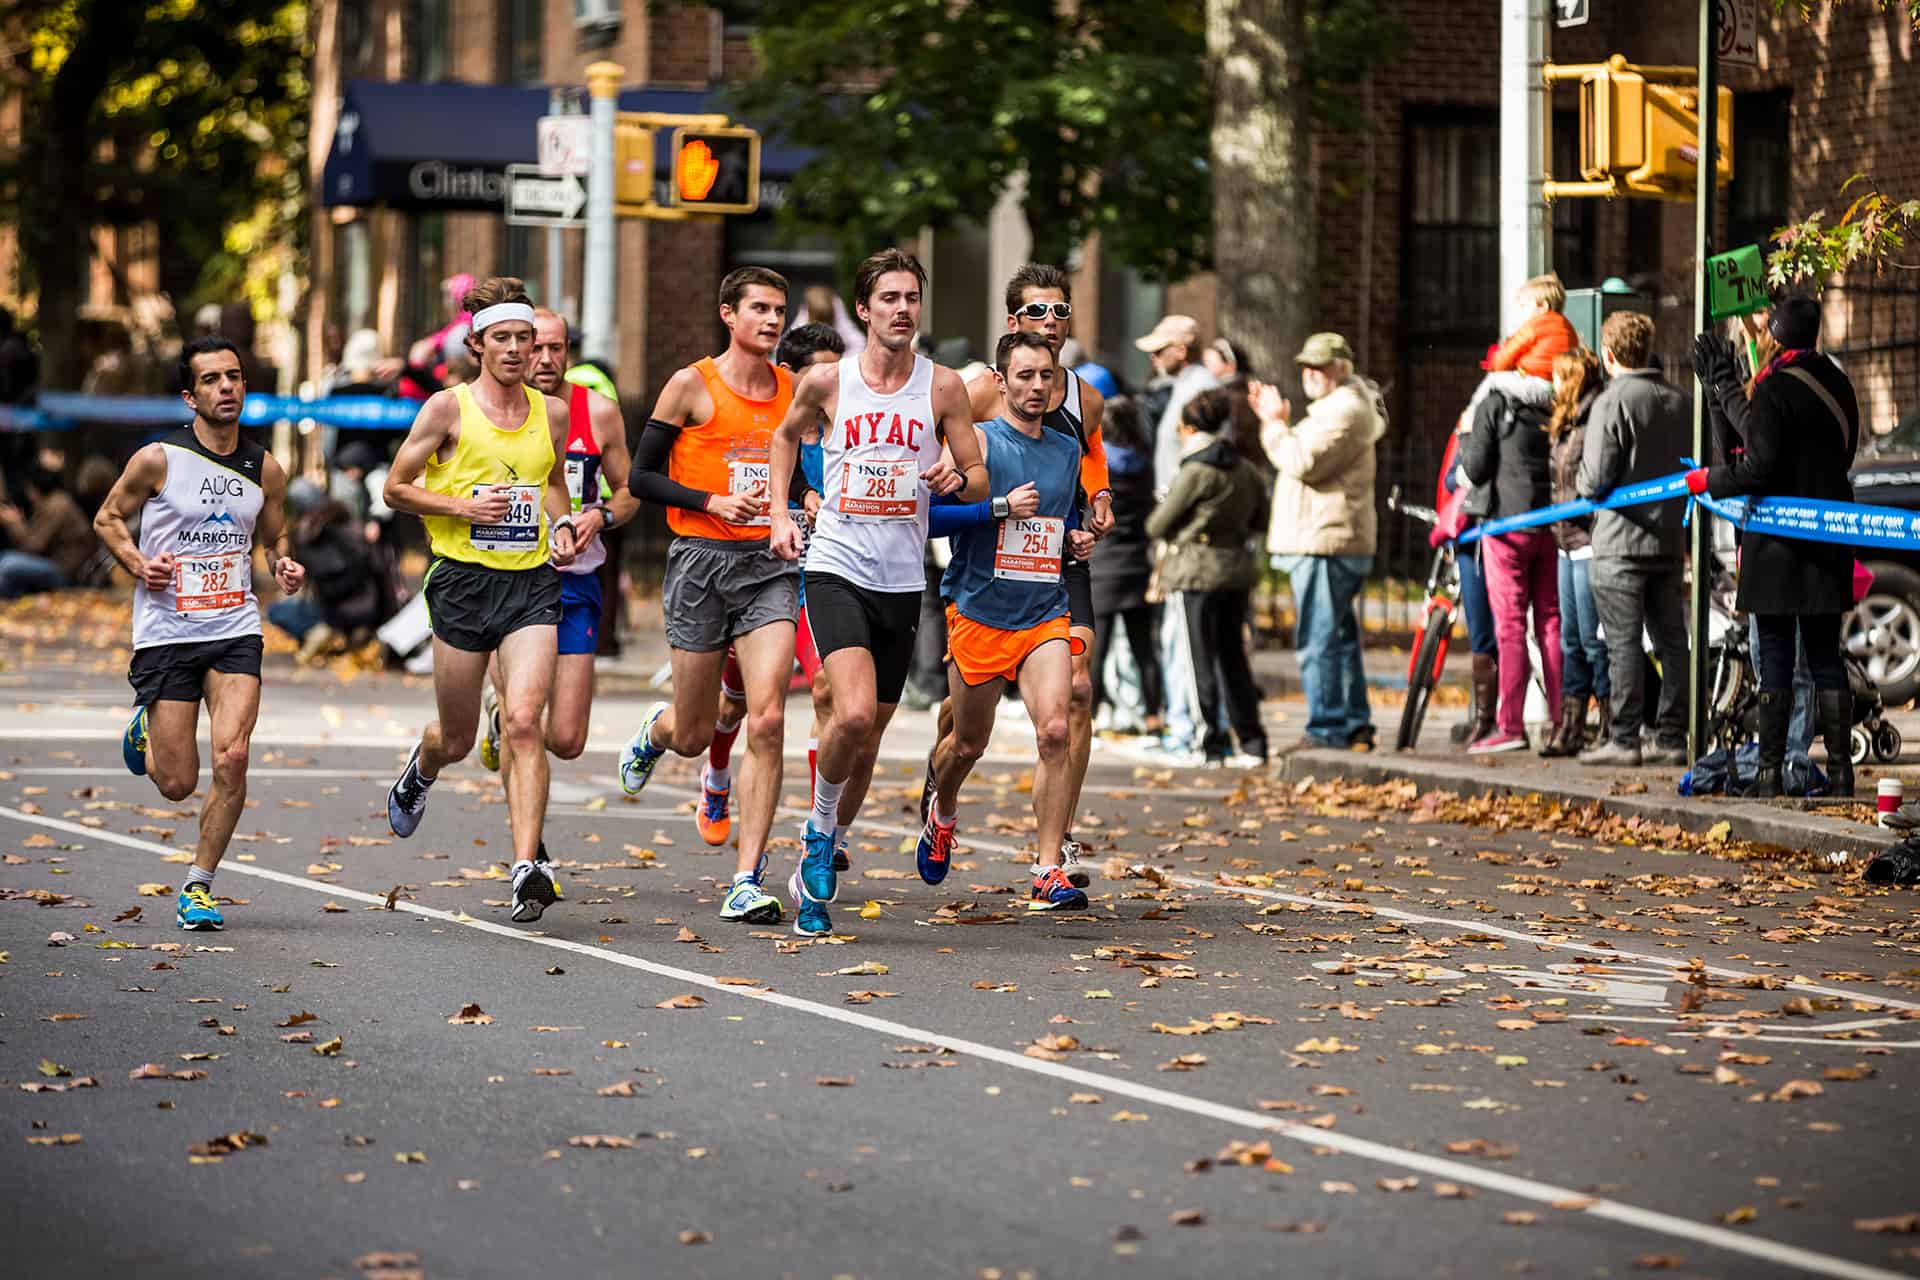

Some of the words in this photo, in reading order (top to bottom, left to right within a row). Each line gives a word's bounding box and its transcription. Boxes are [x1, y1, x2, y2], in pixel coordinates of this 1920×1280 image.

[409, 160, 503, 200] Clinto
[1717, 257, 1737, 278] GO
[845, 412, 923, 452] NYAC
[744, 467, 768, 478] ING
[859, 465, 887, 476] ING
[200, 475, 243, 496] AÜG
[866, 478, 896, 497] 284
[1016, 521, 1041, 532] ING
[1022, 534, 1048, 554] 254
[192, 561, 219, 572] ING
[202, 572, 228, 592] 282
